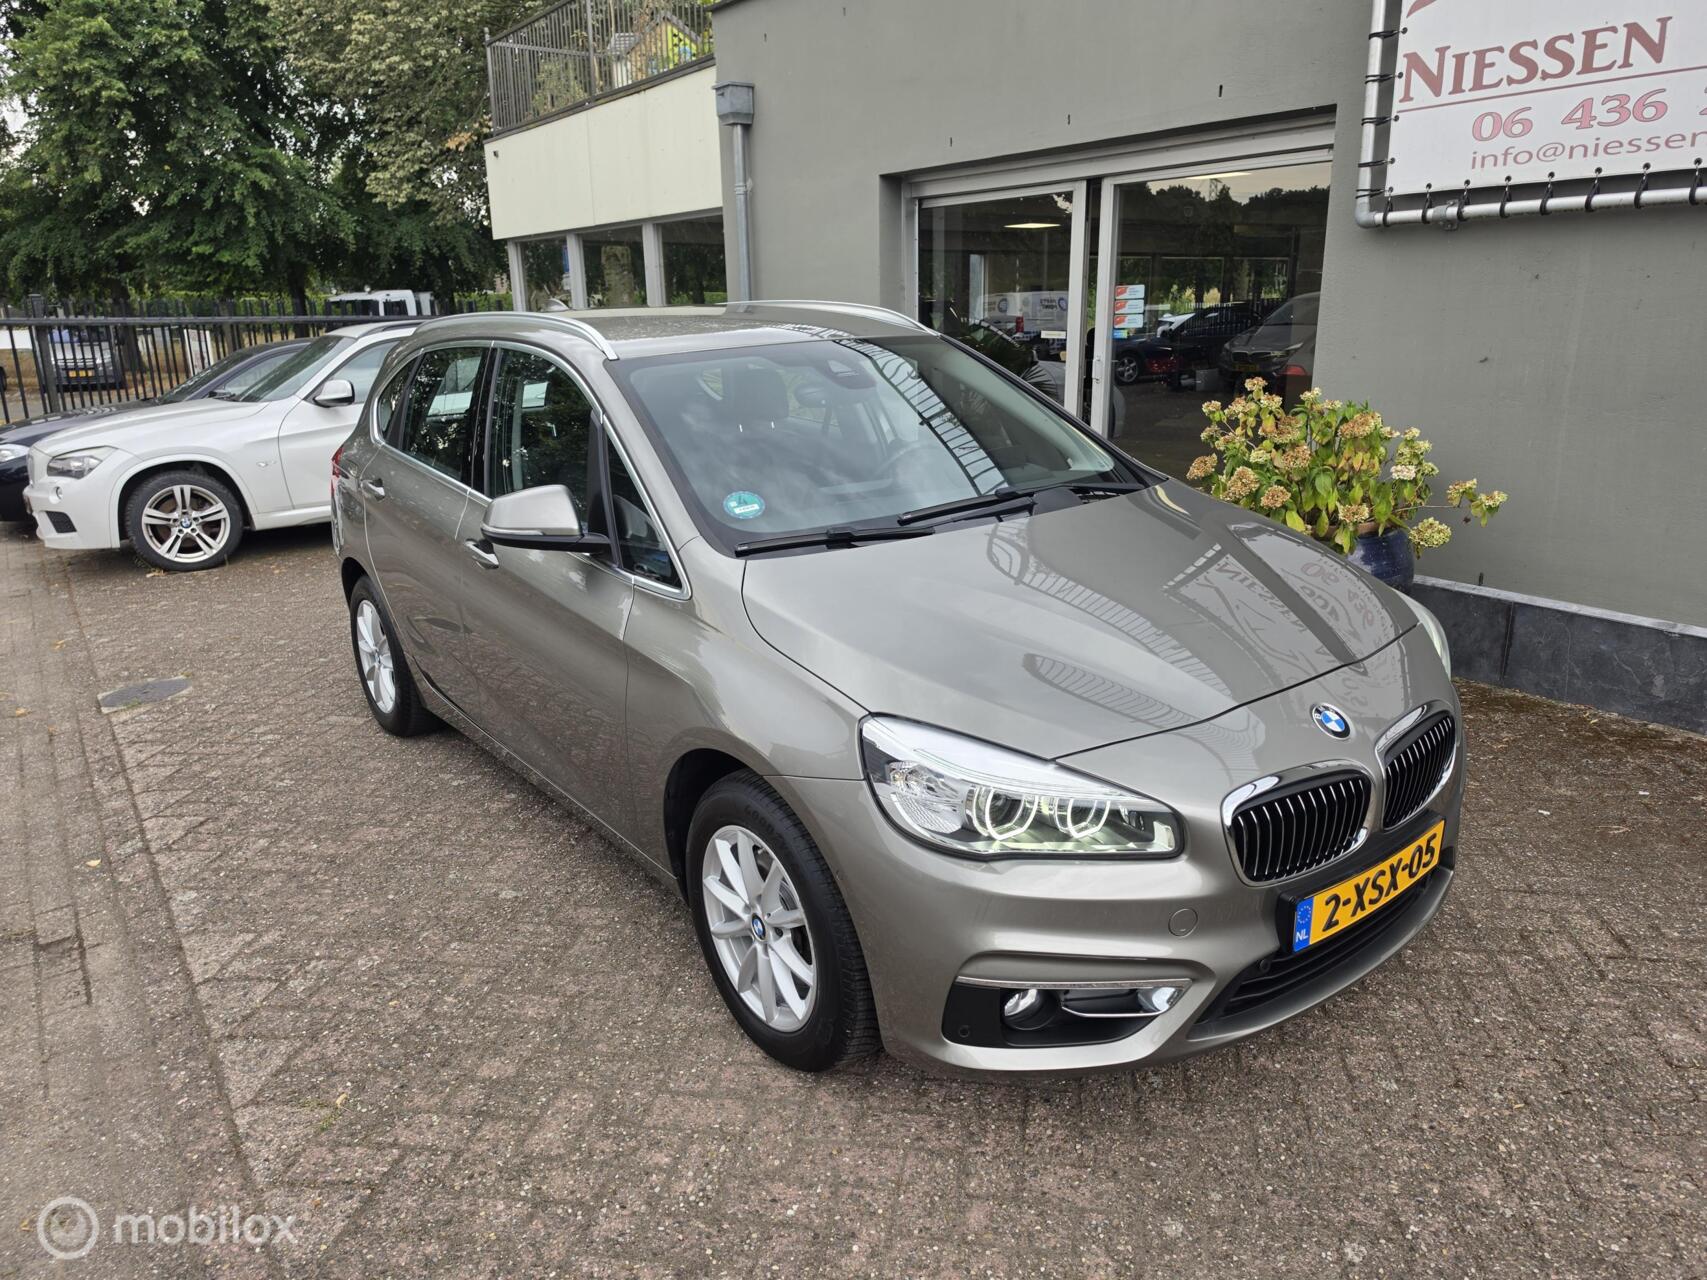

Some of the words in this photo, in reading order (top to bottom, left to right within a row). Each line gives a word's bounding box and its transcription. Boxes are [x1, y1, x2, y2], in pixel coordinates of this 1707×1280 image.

[1399, 16, 1673, 103] NIESSEN
[1471, 106, 1534, 142] 06
[1561, 88, 1668, 130] 436
[1321, 832, 1438, 933] 2-XSX-05
[1295, 930, 1309, 942] NL
